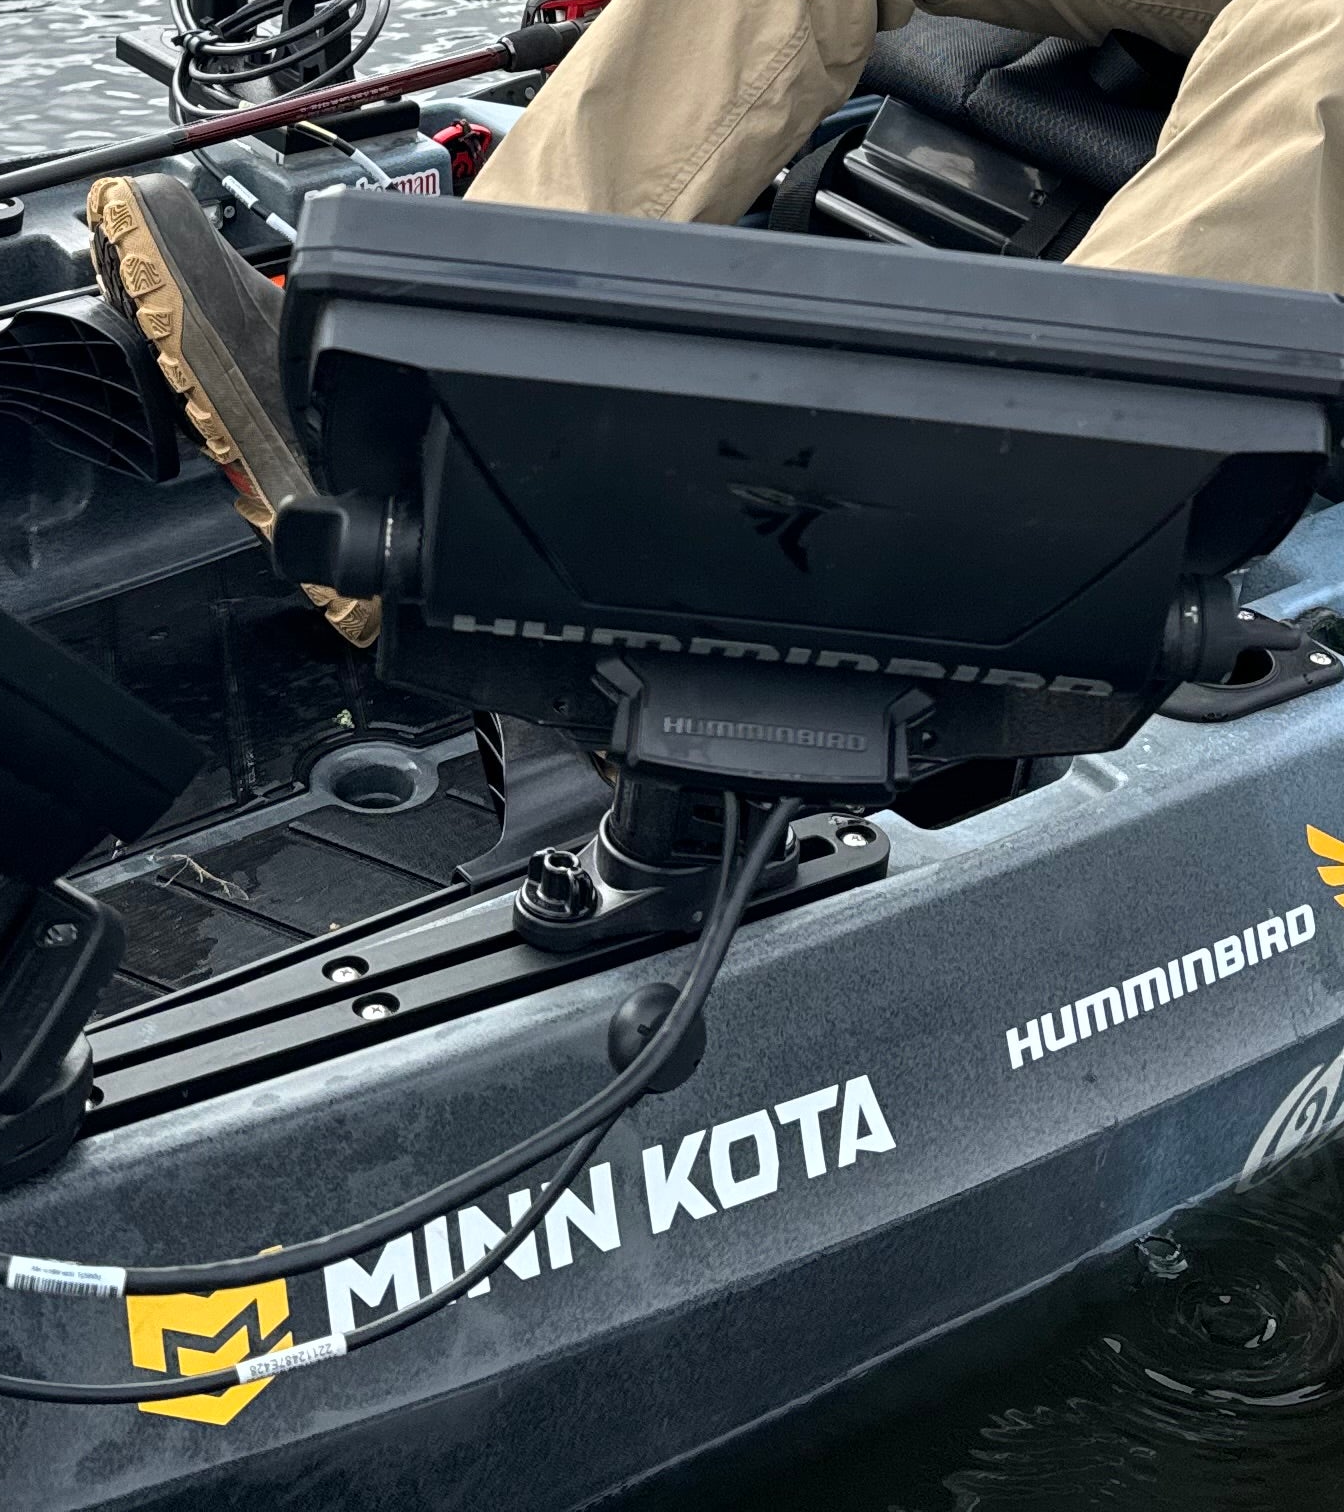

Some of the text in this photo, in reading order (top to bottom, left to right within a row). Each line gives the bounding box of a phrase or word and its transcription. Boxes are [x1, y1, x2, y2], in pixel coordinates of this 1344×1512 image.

[662, 716, 868, 752] HUMMINBIRD
[1005, 903, 1317, 1070] HUMMINBIRD
[325, 1074, 896, 1336] MINN KOTA
